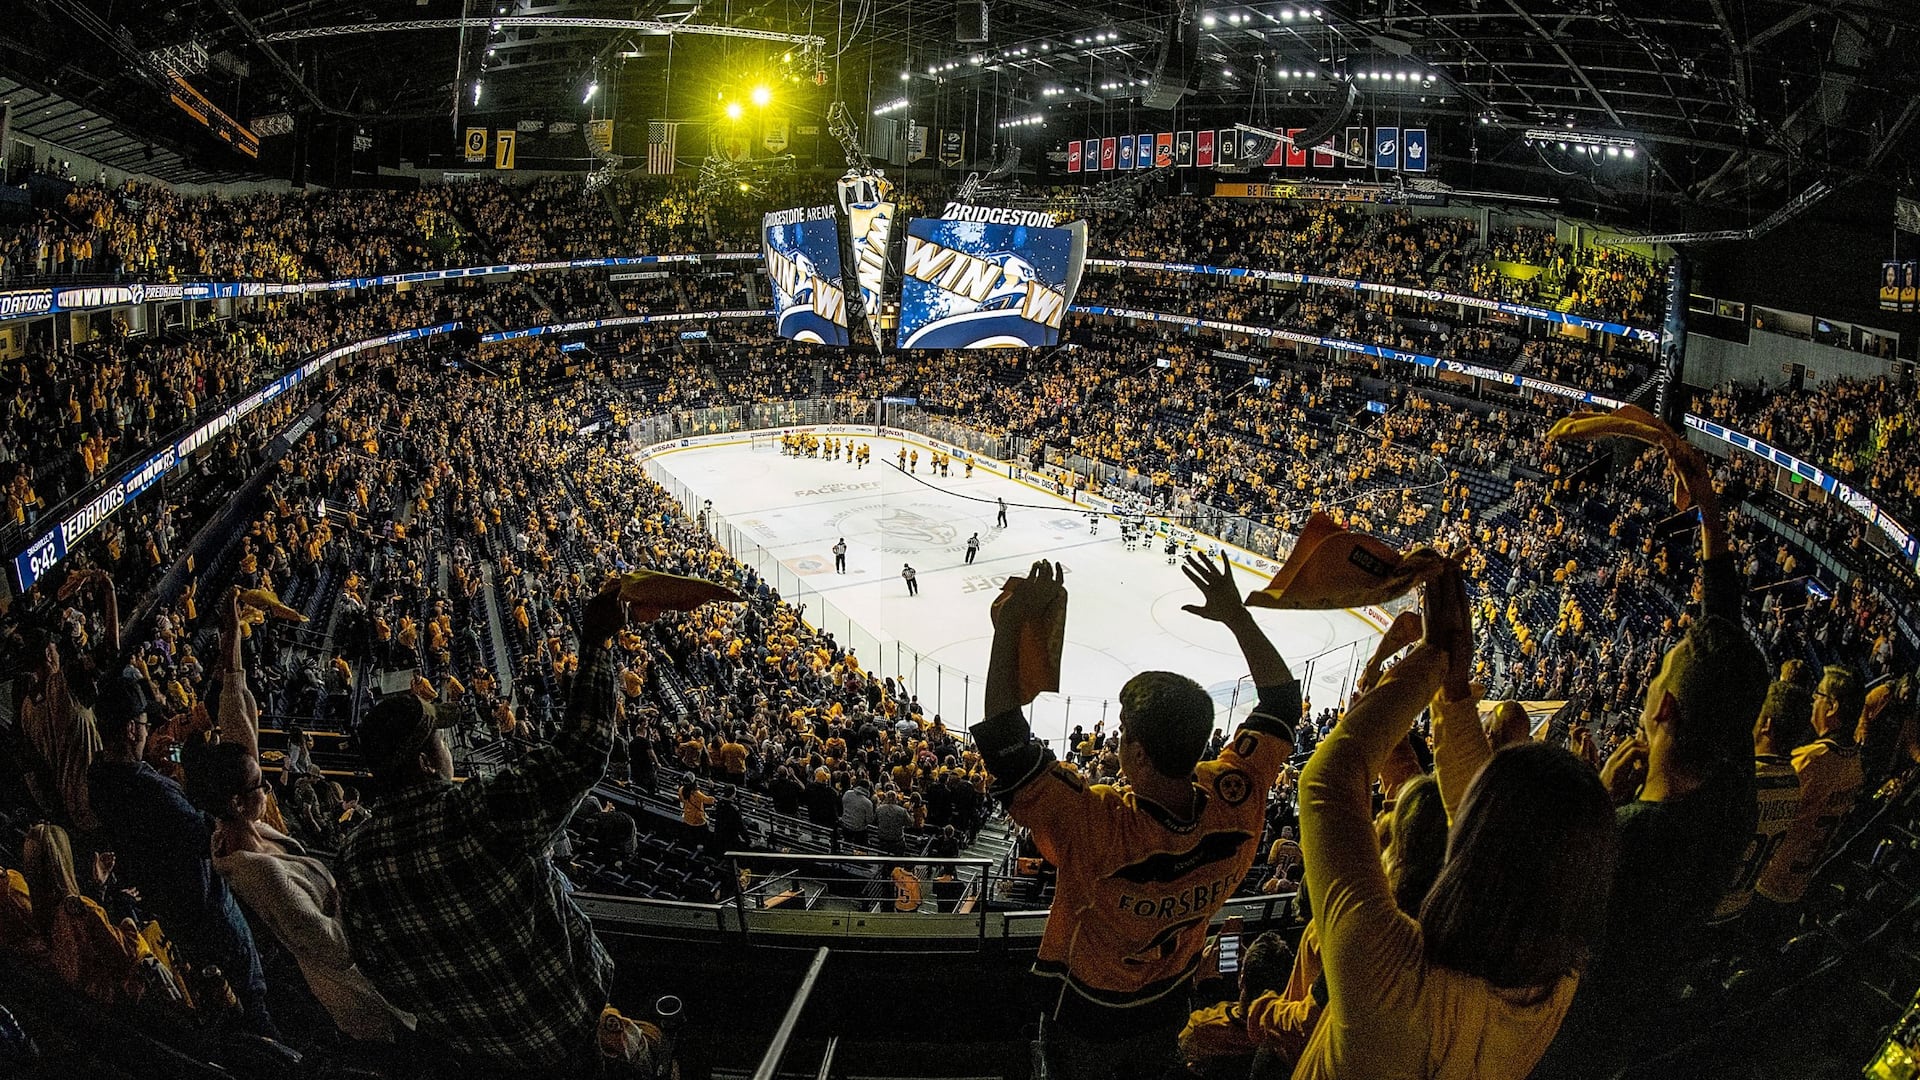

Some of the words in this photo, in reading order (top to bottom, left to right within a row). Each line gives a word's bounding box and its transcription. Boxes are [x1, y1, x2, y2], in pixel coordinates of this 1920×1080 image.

[501, 137, 511, 165] 7
[764, 207, 804, 227] BRIDGESTONE
[807, 204, 836, 221] ARENA
[941, 201, 1057, 229] BRIDGESTONE
[766, 242, 797, 299] WIN
[903, 235, 1004, 303] WIN
[145, 286, 183, 300] PREDATORS
[1442, 294, 1500, 310] PREDATORS
[1665, 265, 1676, 322] HEALTH
[1272, 331, 1321, 346] PREDATORS
[1521, 379, 1587, 401] PREDATORS
[879, 426, 905, 438] HONDA
[651, 442, 676, 454] NISSAN
[794, 481, 881, 498] FACE-OFF
[30, 542, 57, 581] 9:42
